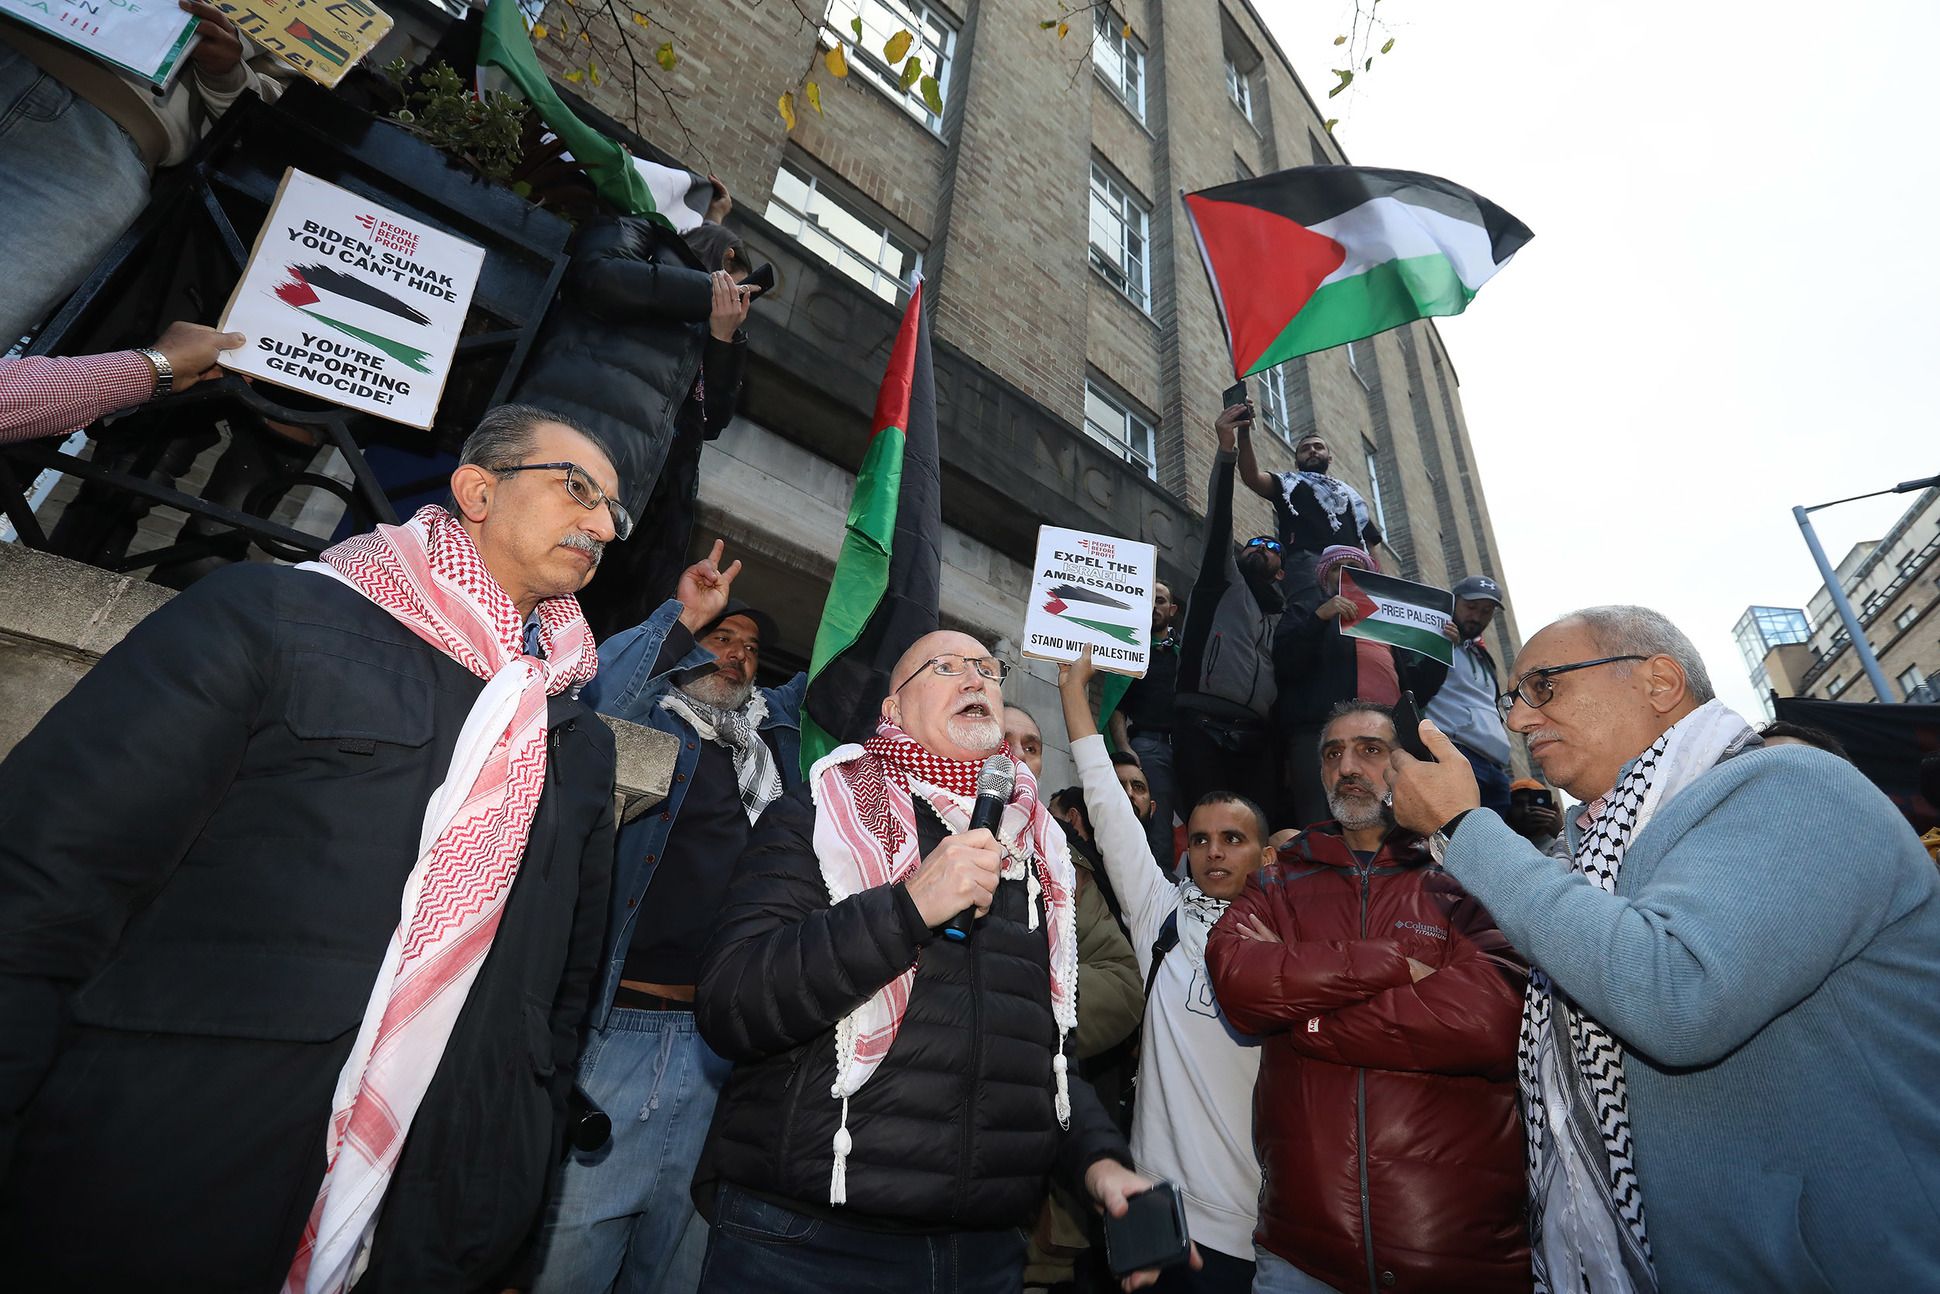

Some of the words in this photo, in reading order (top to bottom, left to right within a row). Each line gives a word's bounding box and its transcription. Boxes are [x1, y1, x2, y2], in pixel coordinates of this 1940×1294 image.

[377, 229, 418, 250] BEFORE
[380, 221, 420, 241] PEOPLE
[302, 219, 375, 260] BIDEN,
[381, 252, 454, 289] SUNAK
[374, 236, 416, 257] PROFIT
[287, 227, 336, 256] YOU
[338, 250, 406, 282] CAN'T
[407, 276, 458, 304] HIDE
[301, 331, 386, 371] YOU'RE
[257, 337, 411, 396] SUPPORTING
[265, 357, 395, 405] GENOCIDE!
[1090, 550, 1115, 559] PROFIT
[1091, 540, 1115, 549] PEOPLE
[1091, 545, 1115, 554] BEFORE
[1054, 550, 1103, 569] EXPEL
[1106, 561, 1138, 576] THE
[1062, 562, 1127, 584] ISRAELI
[1043, 569, 1145, 597] AMBASSADOR
[1381, 603, 1405, 619] FREE
[1030, 633, 1063, 649] STAND
[1065, 639, 1086, 653] WIT
[1092, 644, 1145, 663] PALESTINE
[1404, 920, 1448, 936] Columbia
[1415, 929, 1447, 941] TITANIUM
